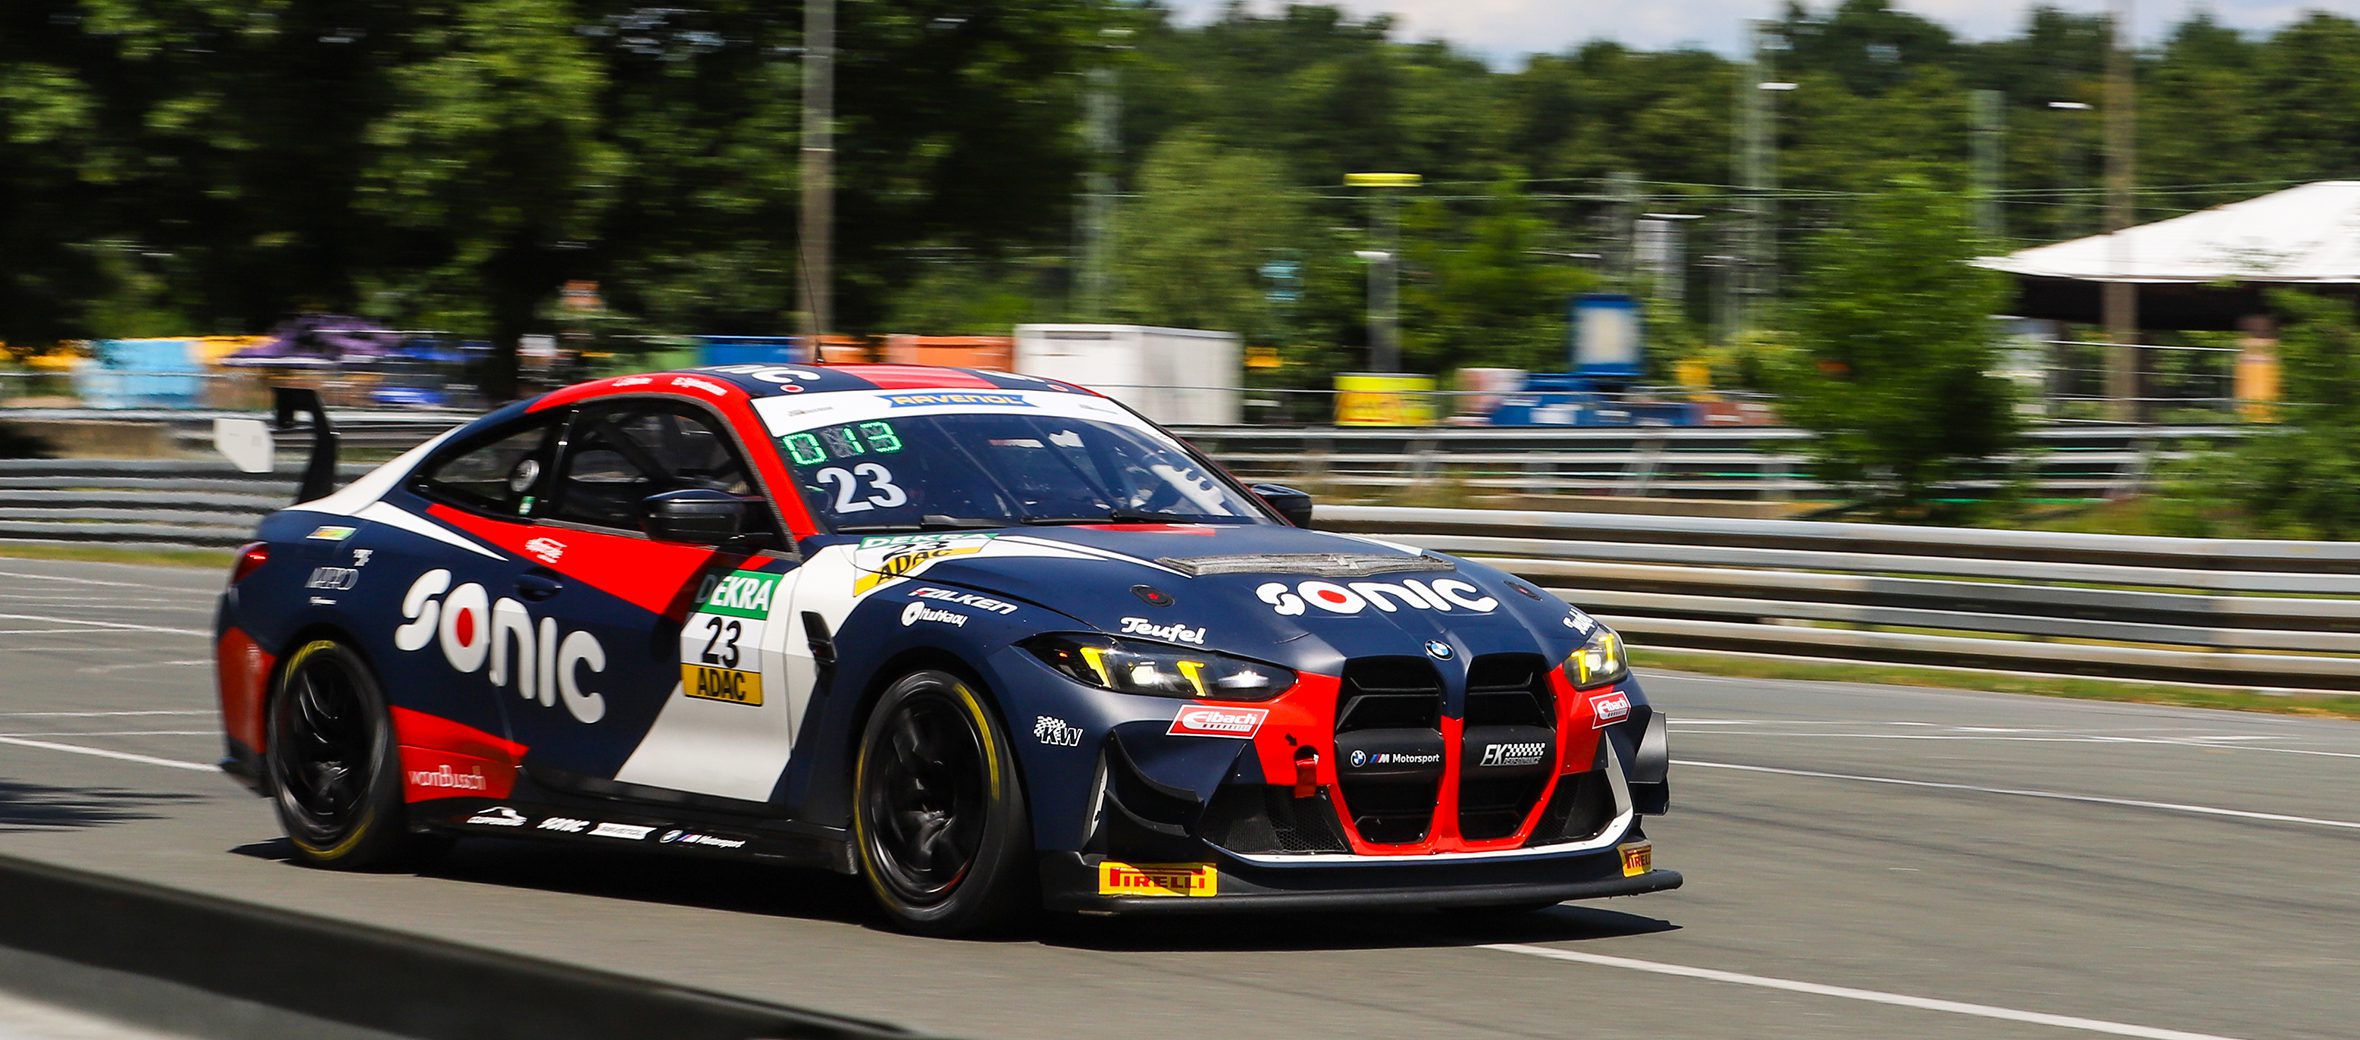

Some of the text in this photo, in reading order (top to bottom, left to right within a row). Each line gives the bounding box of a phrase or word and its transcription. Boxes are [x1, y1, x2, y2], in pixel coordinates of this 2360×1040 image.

[891, 394, 1025, 405] RAVENOL
[781, 421, 902, 465] 013
[816, 463, 907, 514] 23
[877, 549, 952, 584] ADAC
[695, 574, 774, 611] DEKRA
[908, 587, 1018, 615] FALKEN
[702, 616, 742, 669] 23
[1120, 617, 1206, 645] Teufel
[697, 668, 746, 701] ADAC
[1182, 711, 1257, 731] Eibach
[1040, 726, 1083, 747] KW
[1392, 753, 1440, 765] Motorsport
[1480, 744, 1508, 766] FK
[1110, 868, 1206, 889] PIRELLI
